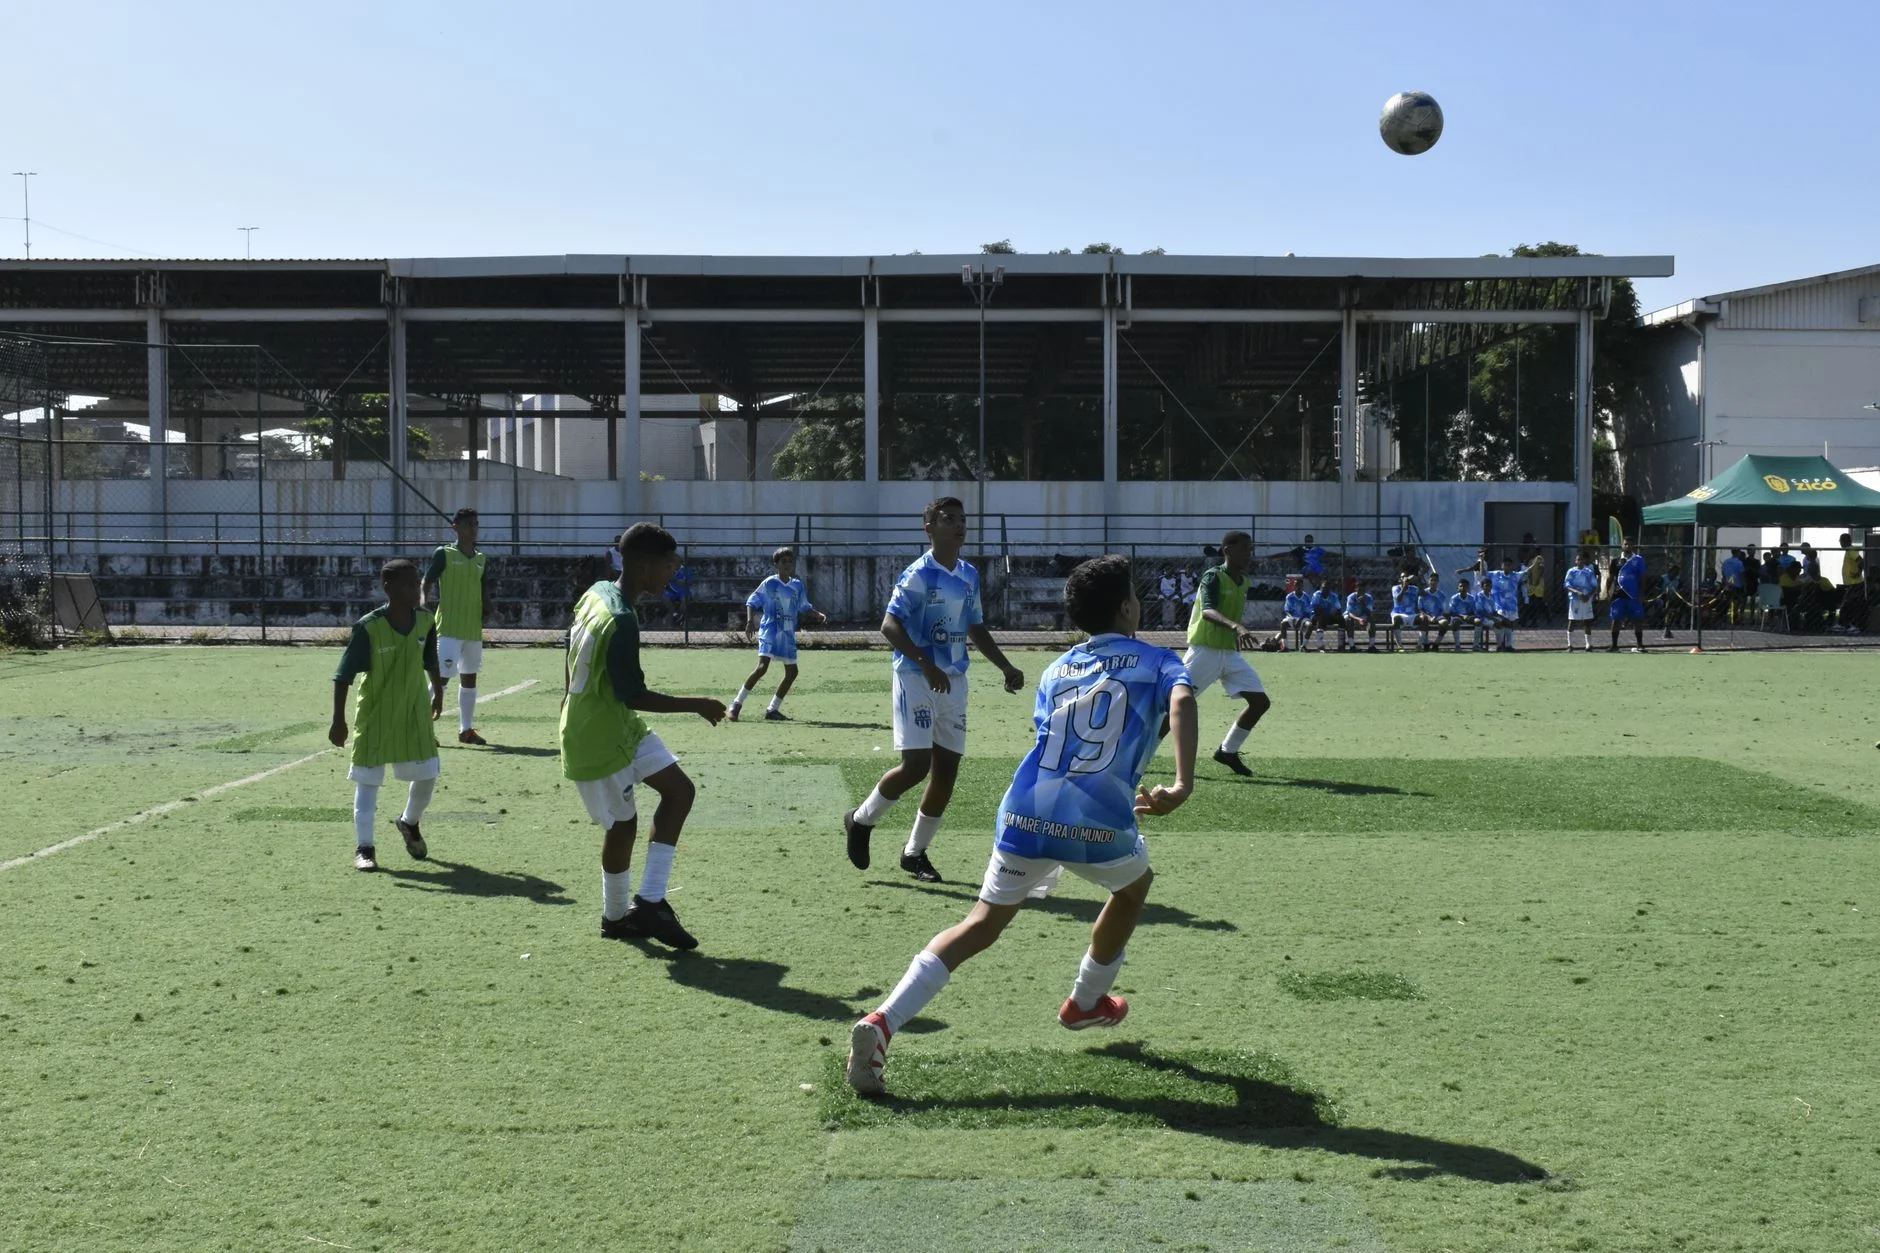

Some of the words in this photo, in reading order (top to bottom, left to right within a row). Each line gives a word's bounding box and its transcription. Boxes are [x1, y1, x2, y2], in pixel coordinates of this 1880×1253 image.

[1796, 482, 1837, 490] ZICO
[1038, 677, 1129, 774] 19
[1004, 811, 1016, 827] DA
[1041, 820, 1068, 839] PARA
[1070, 826, 1078, 840] O
[1080, 827, 1115, 843] MUNDO
